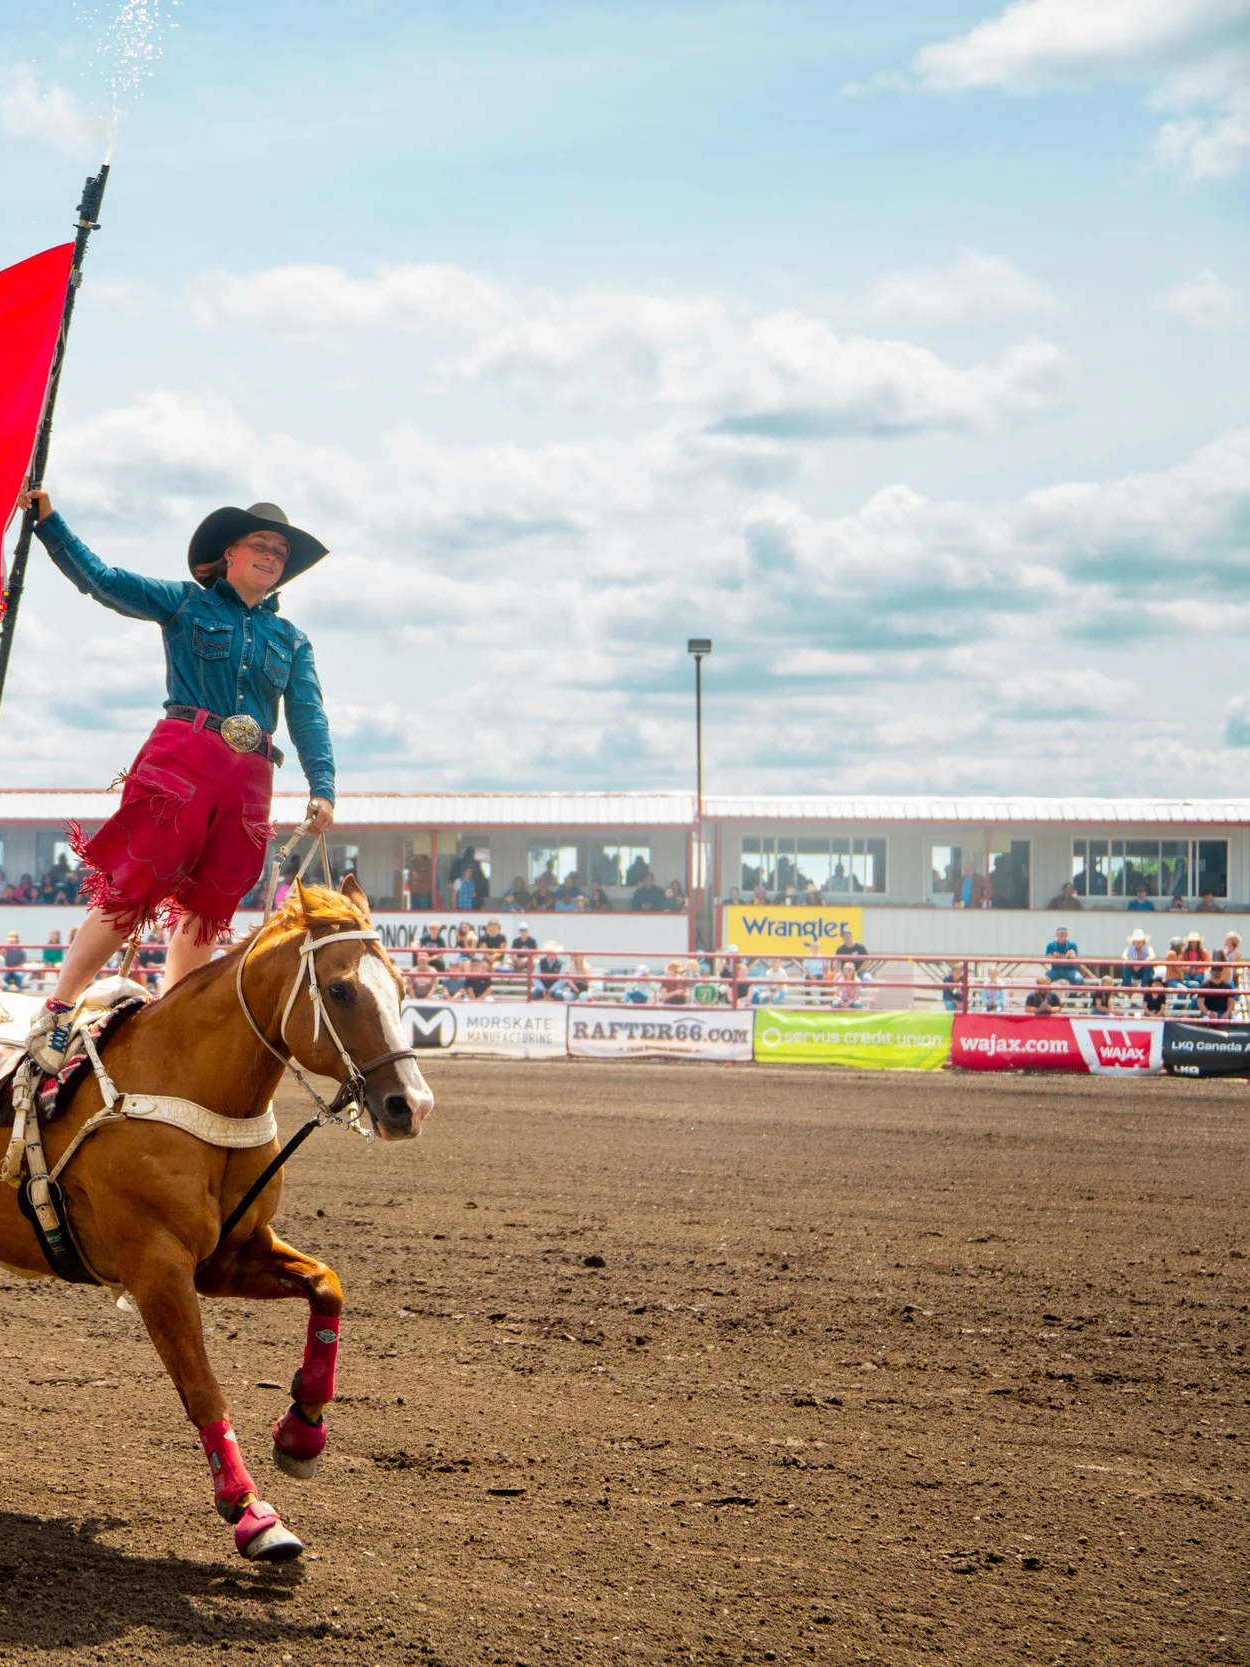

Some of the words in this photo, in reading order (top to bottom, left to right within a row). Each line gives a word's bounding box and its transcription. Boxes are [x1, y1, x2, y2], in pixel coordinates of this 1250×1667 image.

[742, 915, 849, 942] Wrangler
[467, 1016, 552, 1031] MORSKATE
[467, 1031, 553, 1045] MANUFACTURING
[573, 1021, 748, 1044] RAFTER66.COM
[784, 1032, 840, 1046] servus
[844, 1030, 892, 1046] credit
[896, 1032, 944, 1047] union
[960, 1036, 1070, 1056] wajax.com
[1100, 1046, 1145, 1062] WAJAX
[1171, 1040, 1194, 1052] LKQ
[1196, 1041, 1243, 1053] Canada
[1173, 1064, 1200, 1075] LKQ
